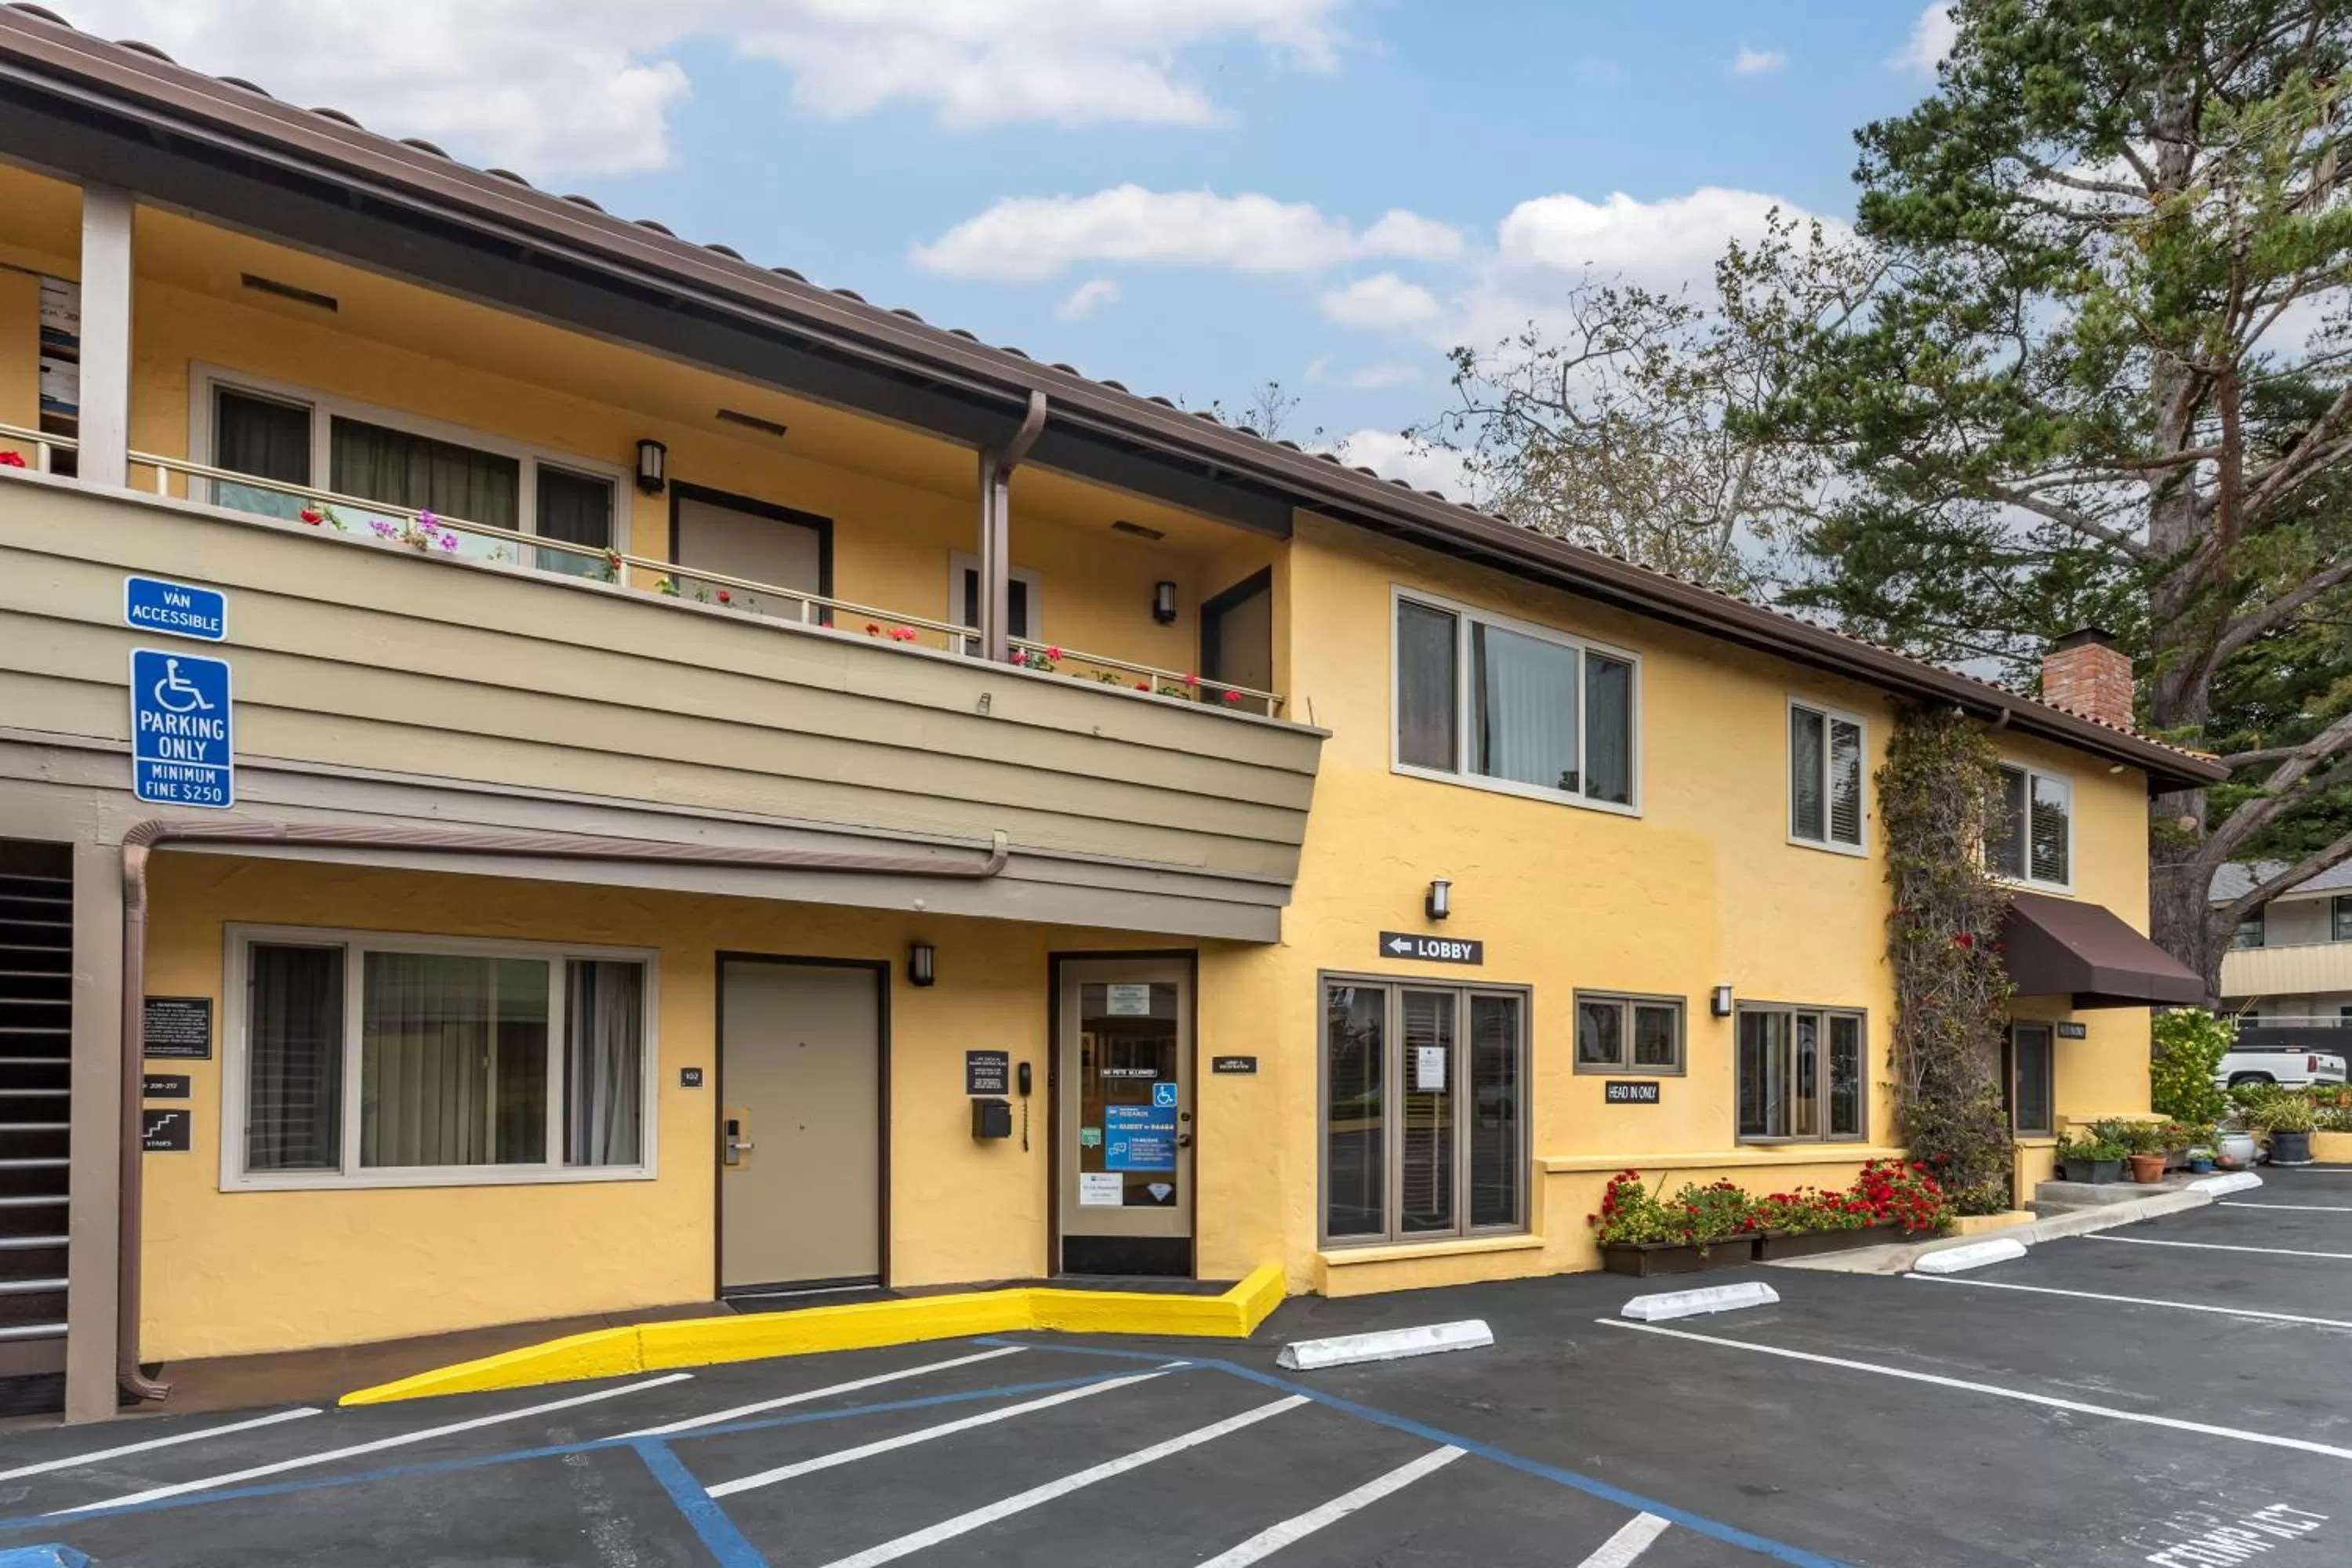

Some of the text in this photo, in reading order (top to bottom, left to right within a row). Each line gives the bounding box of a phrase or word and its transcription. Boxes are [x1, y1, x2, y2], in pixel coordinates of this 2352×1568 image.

[163, 590, 191, 608] VAN
[132, 604, 220, 632] ACCESSIBLE
[140, 710, 224, 741] PARKING
[159, 736, 207, 762] ONLY
[151, 764, 216, 784] MINIMUM
[145, 782, 222, 802] FINE $250
[1418, 939, 1472, 960] LOBBY
[1609, 1086, 1657, 1098] HEAD IN ONLY
